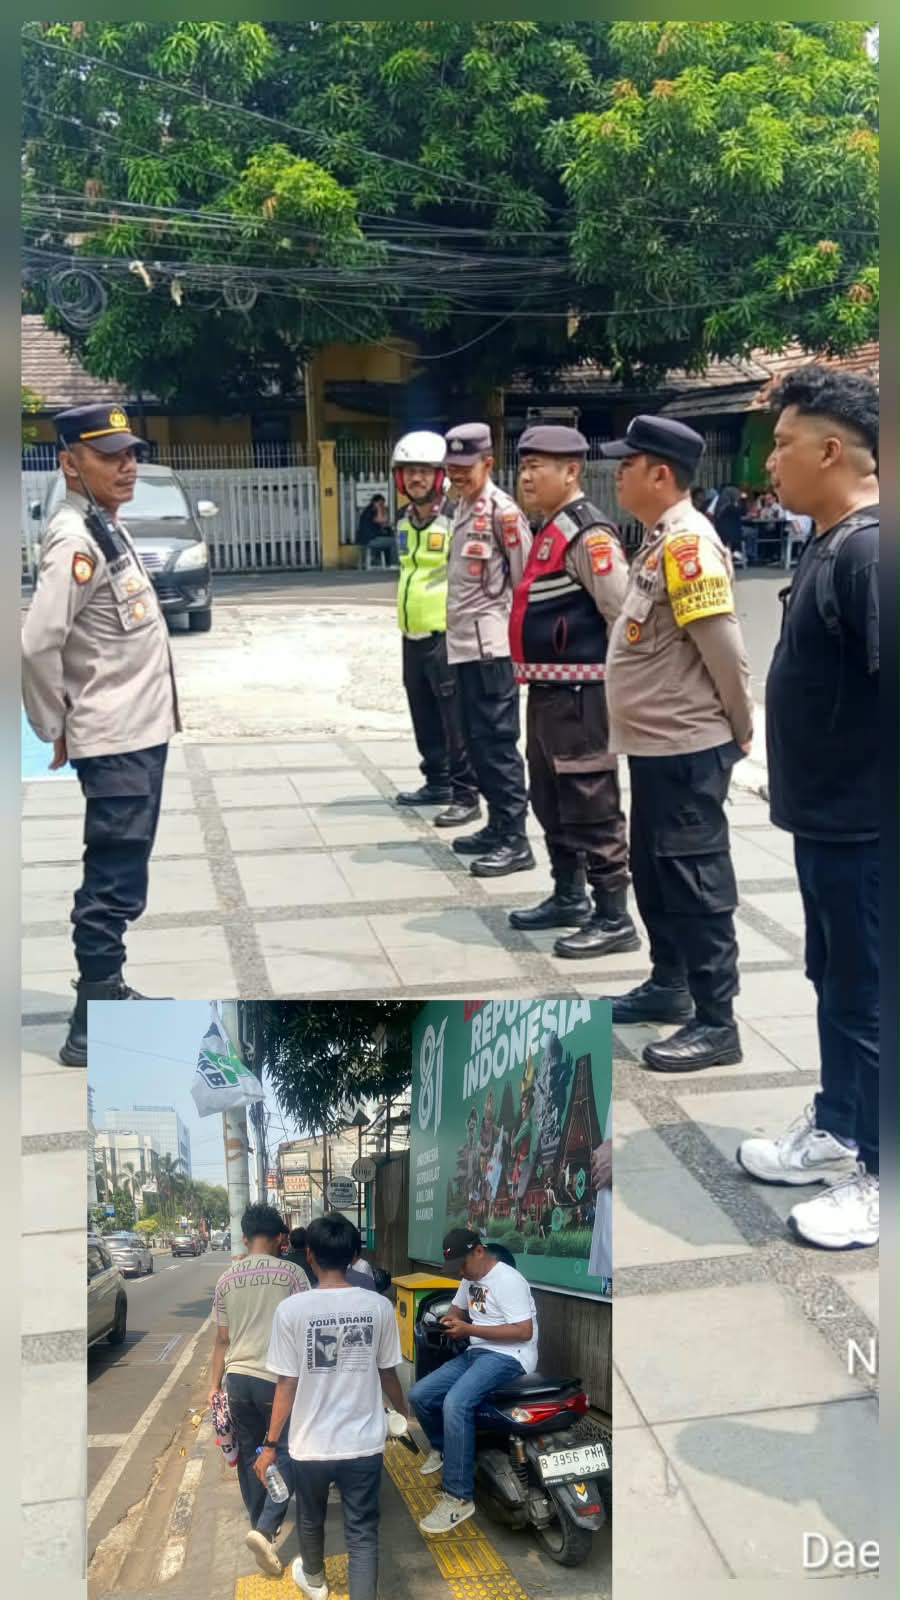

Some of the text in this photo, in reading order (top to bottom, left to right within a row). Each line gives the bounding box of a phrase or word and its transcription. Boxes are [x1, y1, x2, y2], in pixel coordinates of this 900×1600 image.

[418, 1016, 448, 1136] 81
[463, 1000, 591, 1100] INDONESIA
[309, 1316, 373, 1328] YOUR BRAND
[541, 1458, 548, 1469] B
[552, 1451, 580, 1467] 3956
